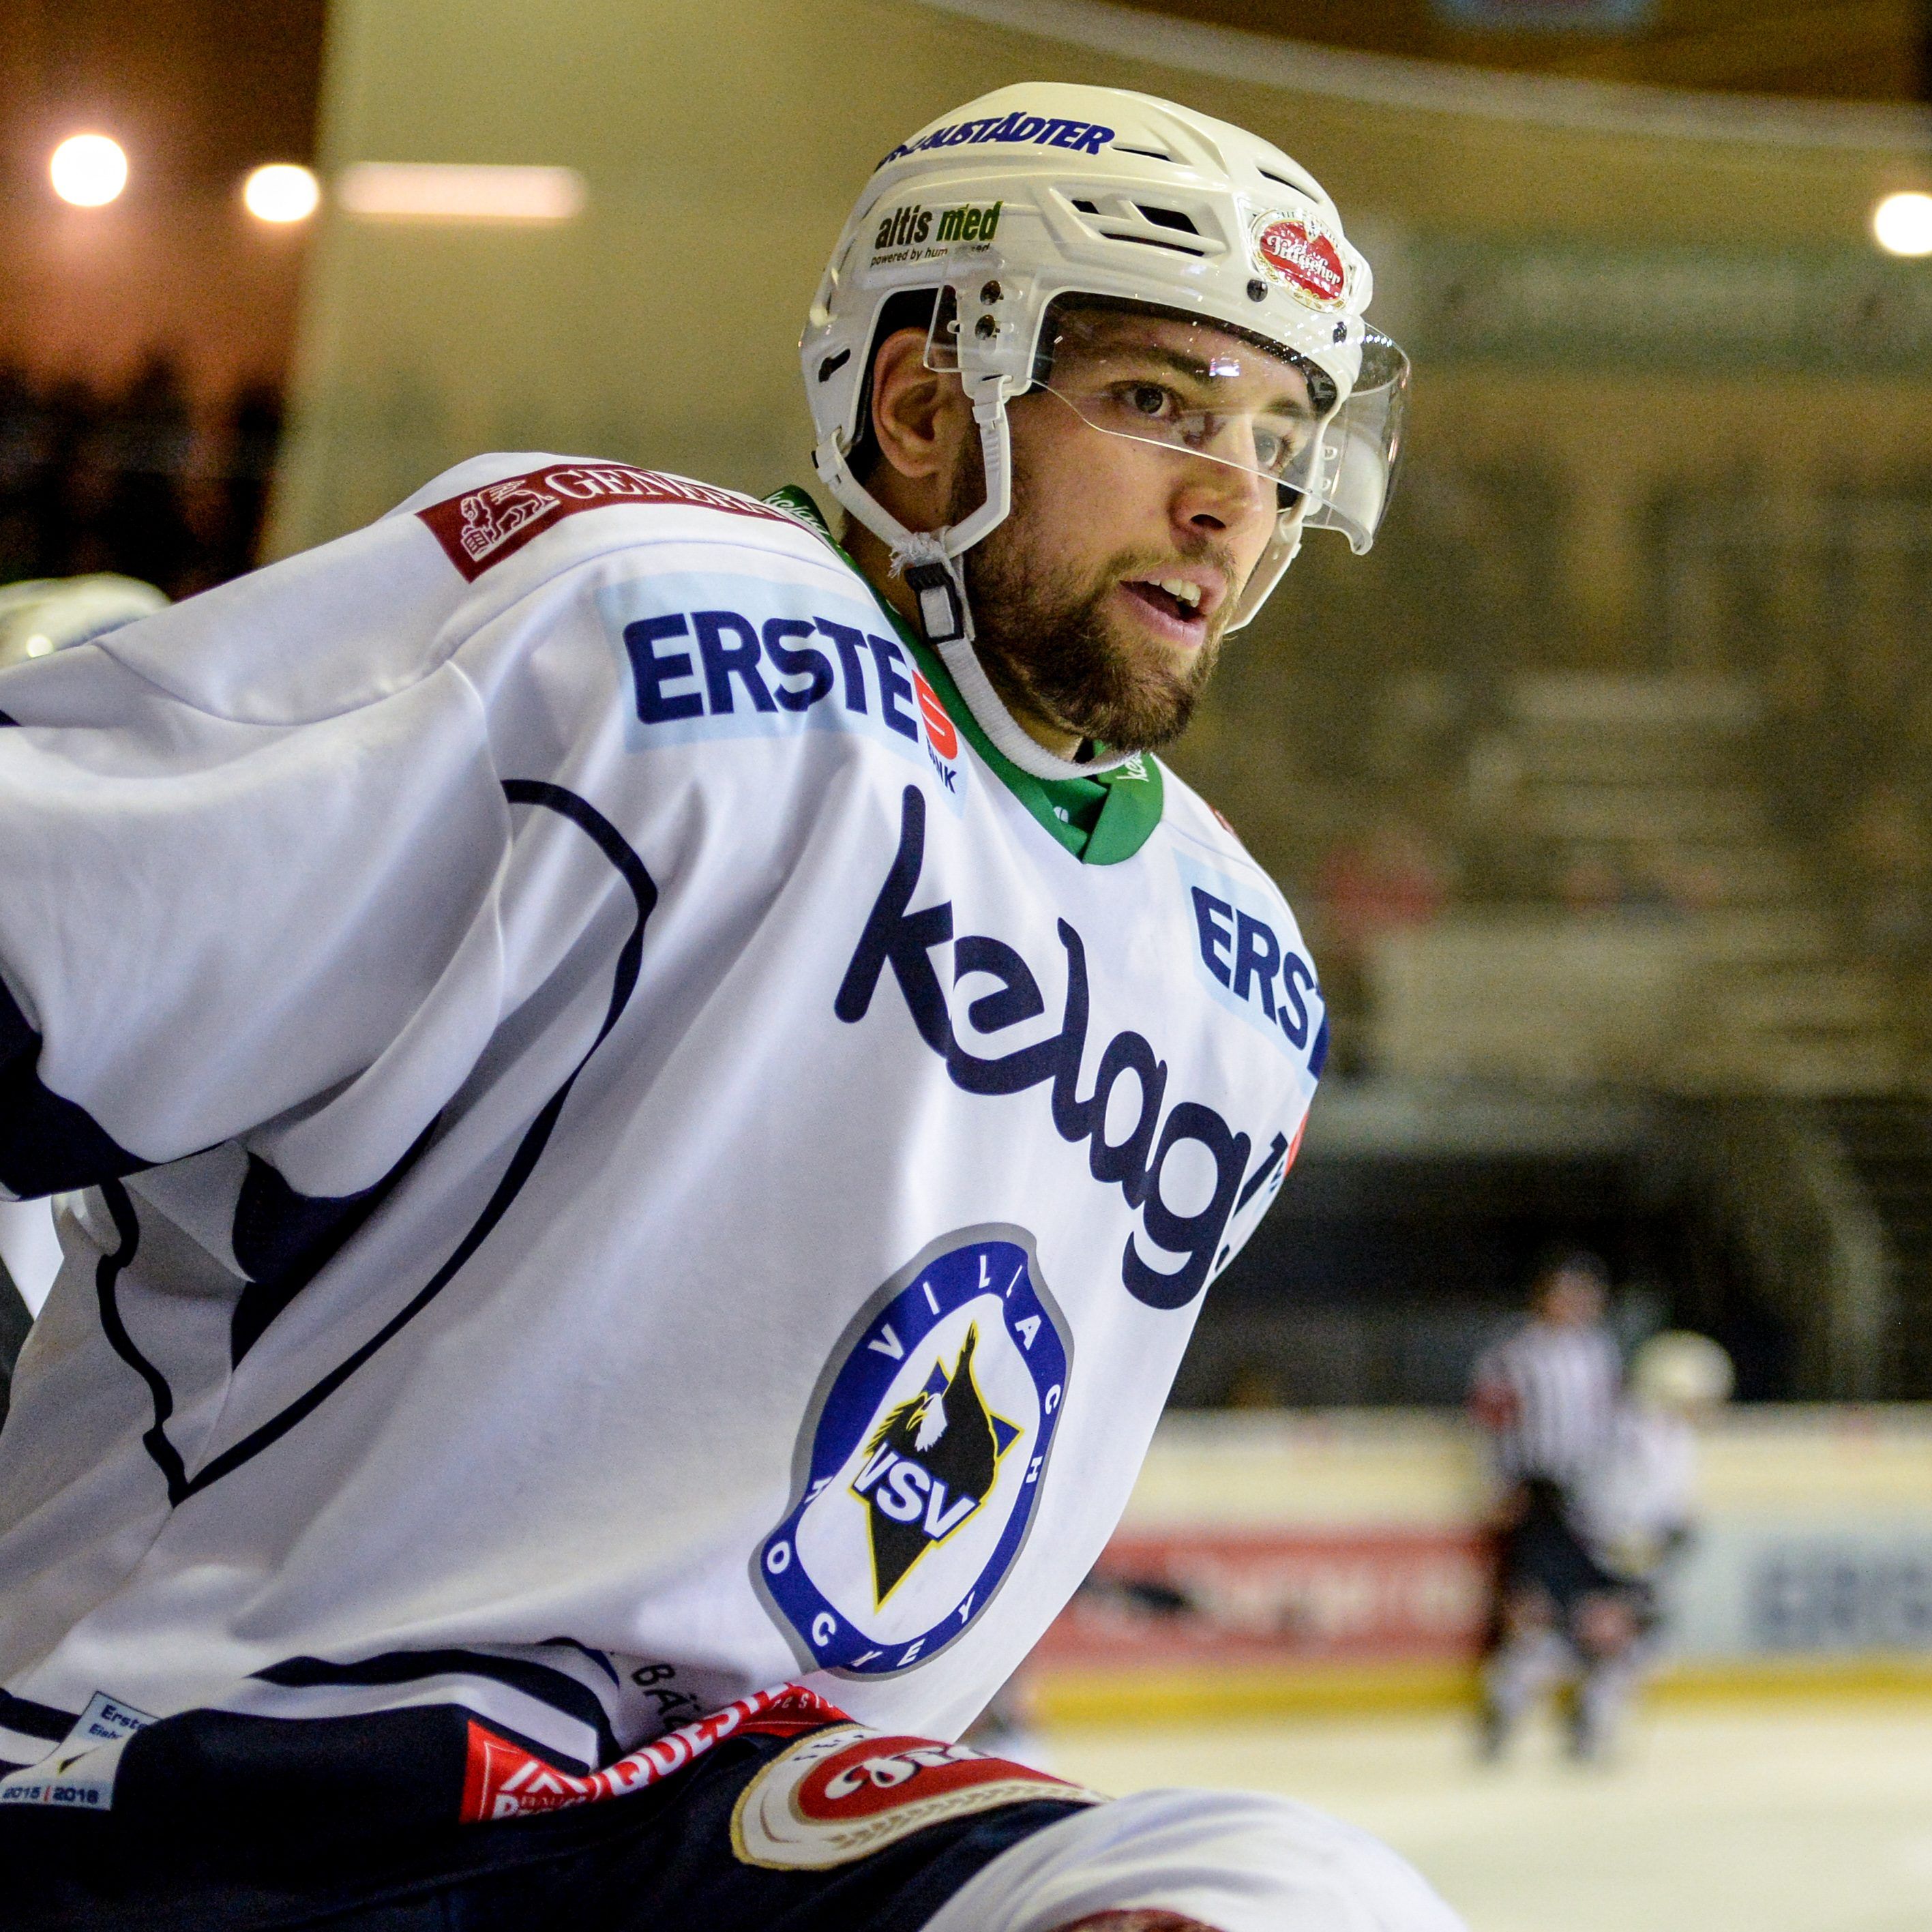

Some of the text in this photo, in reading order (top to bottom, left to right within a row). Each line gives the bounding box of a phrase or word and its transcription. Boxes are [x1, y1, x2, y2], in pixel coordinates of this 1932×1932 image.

[870, 249, 910, 267] powered
[910, 248, 923, 261] by
[875, 201, 1004, 250] altis med
[545, 469, 788, 520] GENERA
[622, 610, 919, 743] ERSTE
[833, 784, 1252, 1311] kelag
[852, 1444, 979, 1539] VSV
